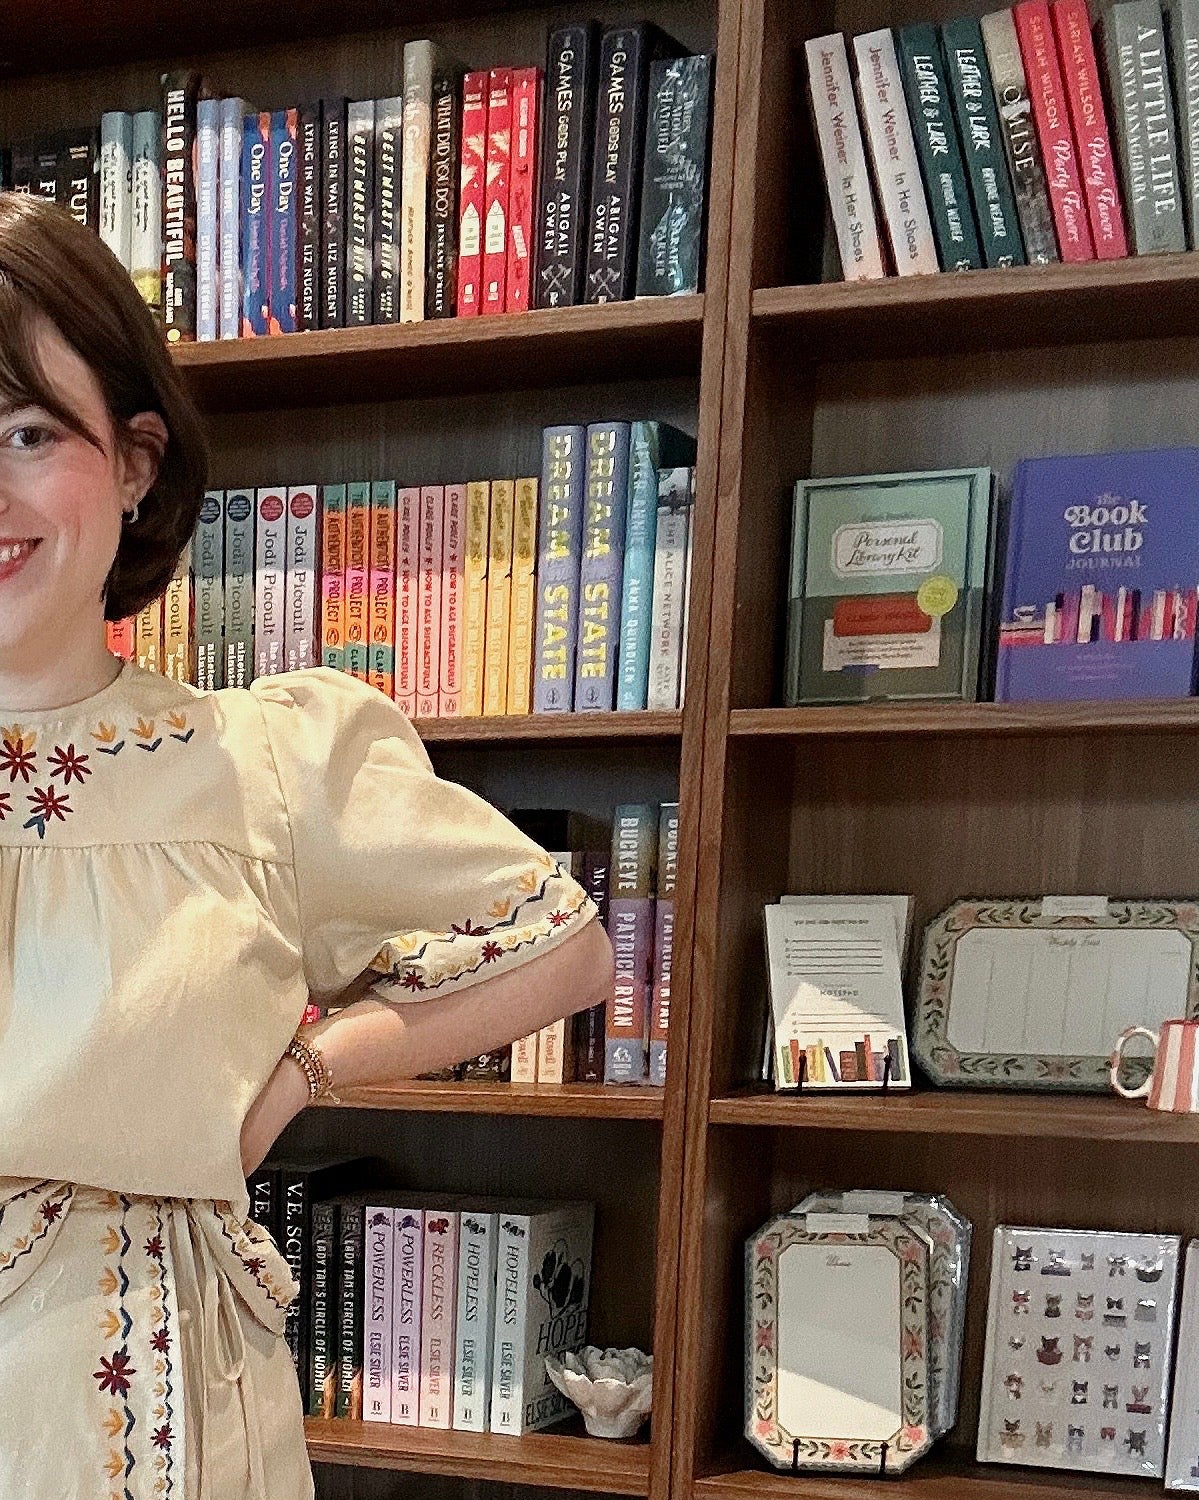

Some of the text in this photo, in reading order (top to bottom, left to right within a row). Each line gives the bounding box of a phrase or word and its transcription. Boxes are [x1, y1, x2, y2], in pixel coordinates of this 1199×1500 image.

[556, 49, 574, 111] GAMES
[608, 51, 627, 114] GAMES
[913, 55, 949, 157] LEATHER LARK
[955, 49, 991, 150] LEATHER LARK
[1041, 73, 1060, 131] WILSON
[1077, 71, 1097, 128] WILSON
[304, 123, 314, 162] LYING
[329, 122, 338, 159] LYING
[381, 130, 394, 175] BEST
[821, 51, 864, 263] Jennifer Weiner Shoes
[869, 47, 919, 260] Jennifer Weiner Shoes
[1140, 49, 1176, 215] LITTLE LIFE
[165, 89, 185, 265] HELLO BEAUTIFUL
[248, 143, 265, 215] One Day
[275, 142, 293, 214] One Day
[353, 134, 366, 283] BEST WORST THING
[544, 202, 557, 250] OWEN
[557, 192, 571, 256] ABIGAIL
[593, 205, 606, 253] OWEN
[606, 195, 621, 260] ABIGAIL
[303, 265, 313, 319] NUGENT
[327, 263, 337, 318] NUGENT
[855, 530, 919, 549] Personal
[1064, 500, 1149, 527] Book
[1069, 527, 1144, 554] Club
[263, 530, 277, 637] Jodi Picoult
[293, 525, 308, 634] Jodi Picoult
[846, 544, 921, 567] Library Kit
[1066, 555, 1142, 571] JOURNAL
[202, 573, 214, 636] Picoult
[232, 573, 245, 633] Picoult
[326, 580, 340, 622] PROJECT
[350, 576, 363, 620] PROJECT
[375, 575, 388, 620] PROJECT
[662, 547, 674, 662] ALICE NETWORK
[542, 584, 568, 680] STATE
[581, 582, 609, 678] STATE
[623, 620, 638, 685] QUINDLEN
[618, 817, 640, 890] BUCKEYE
[613, 912, 637, 1028] PATRICK RYAN
[371, 1231, 386, 1323] POWERLESS
[400, 1234, 415, 1325] POWERLESS
[430, 1242, 445, 1321] RECKLESS
[464, 1243, 480, 1322] HOPELESS
[504, 1246, 518, 1325] HOPELESS
[314, 1240, 327, 1393] LADY CIRCLE WOMEN
[341, 1240, 355, 1393] LADY CIRCLE WOMEN
[536, 1310, 586, 1354] HOPE
[369, 1332, 382, 1389] ELSIE SILVER
[398, 1335, 411, 1393] ELSIE SILVER
